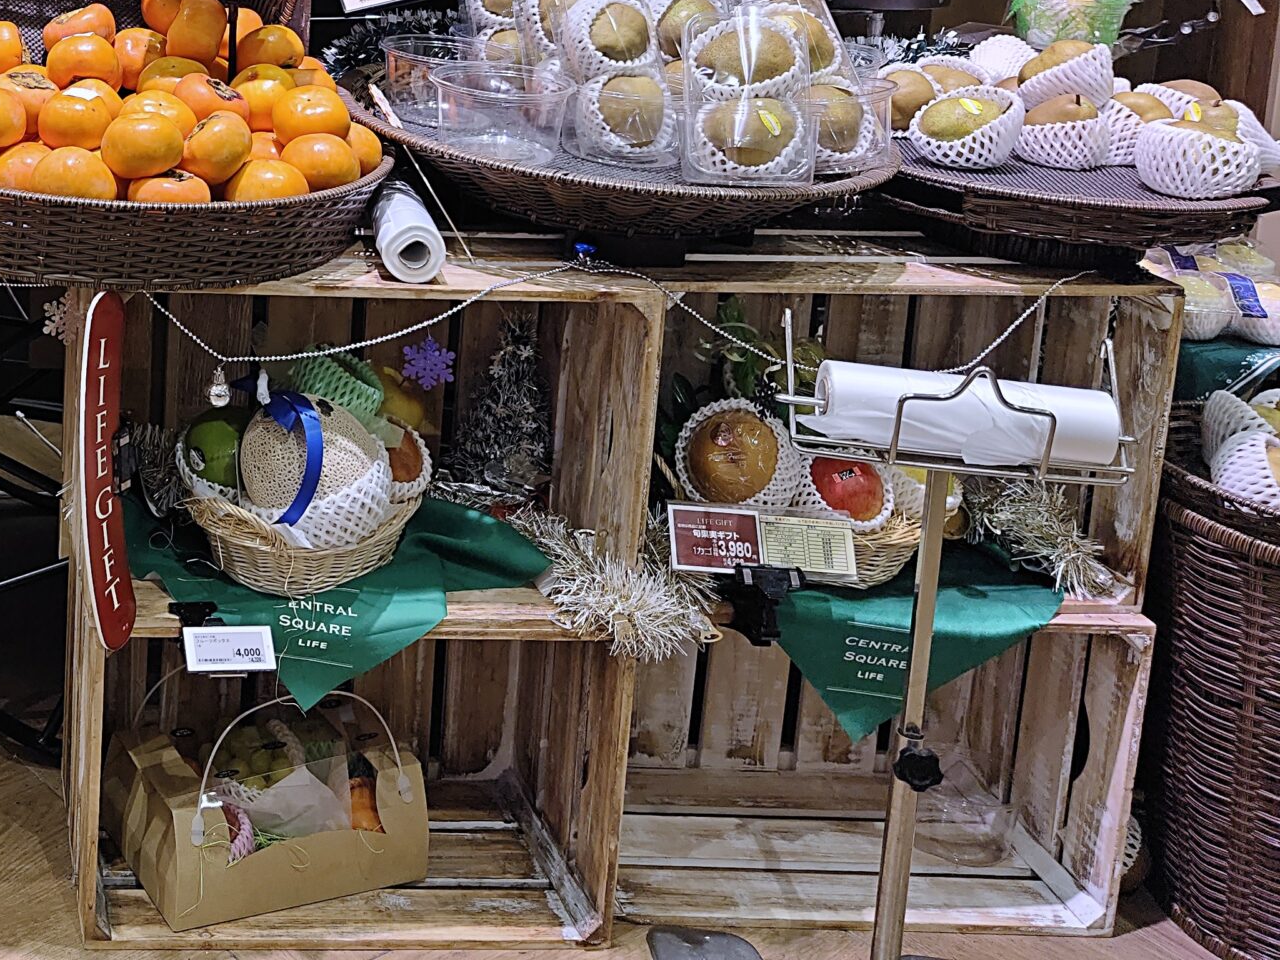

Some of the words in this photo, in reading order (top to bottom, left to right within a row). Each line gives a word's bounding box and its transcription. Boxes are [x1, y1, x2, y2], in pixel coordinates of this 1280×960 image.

[95, 338, 110, 479] LIFE
[692, 529, 740, 540] 旬果実ギフト
[94, 486, 121, 612] GIFT
[718, 541, 752, 558] 3,980
[288, 598, 358, 617] ENTRAL
[279, 614, 352, 636] SQUARE
[298, 638, 328, 649] LIFE
[845, 636, 909, 653] CENTRA
[235, 647, 261, 659] 4,000
[843, 651, 908, 669] SQUARE
[857, 670, 885, 681] LIFE
